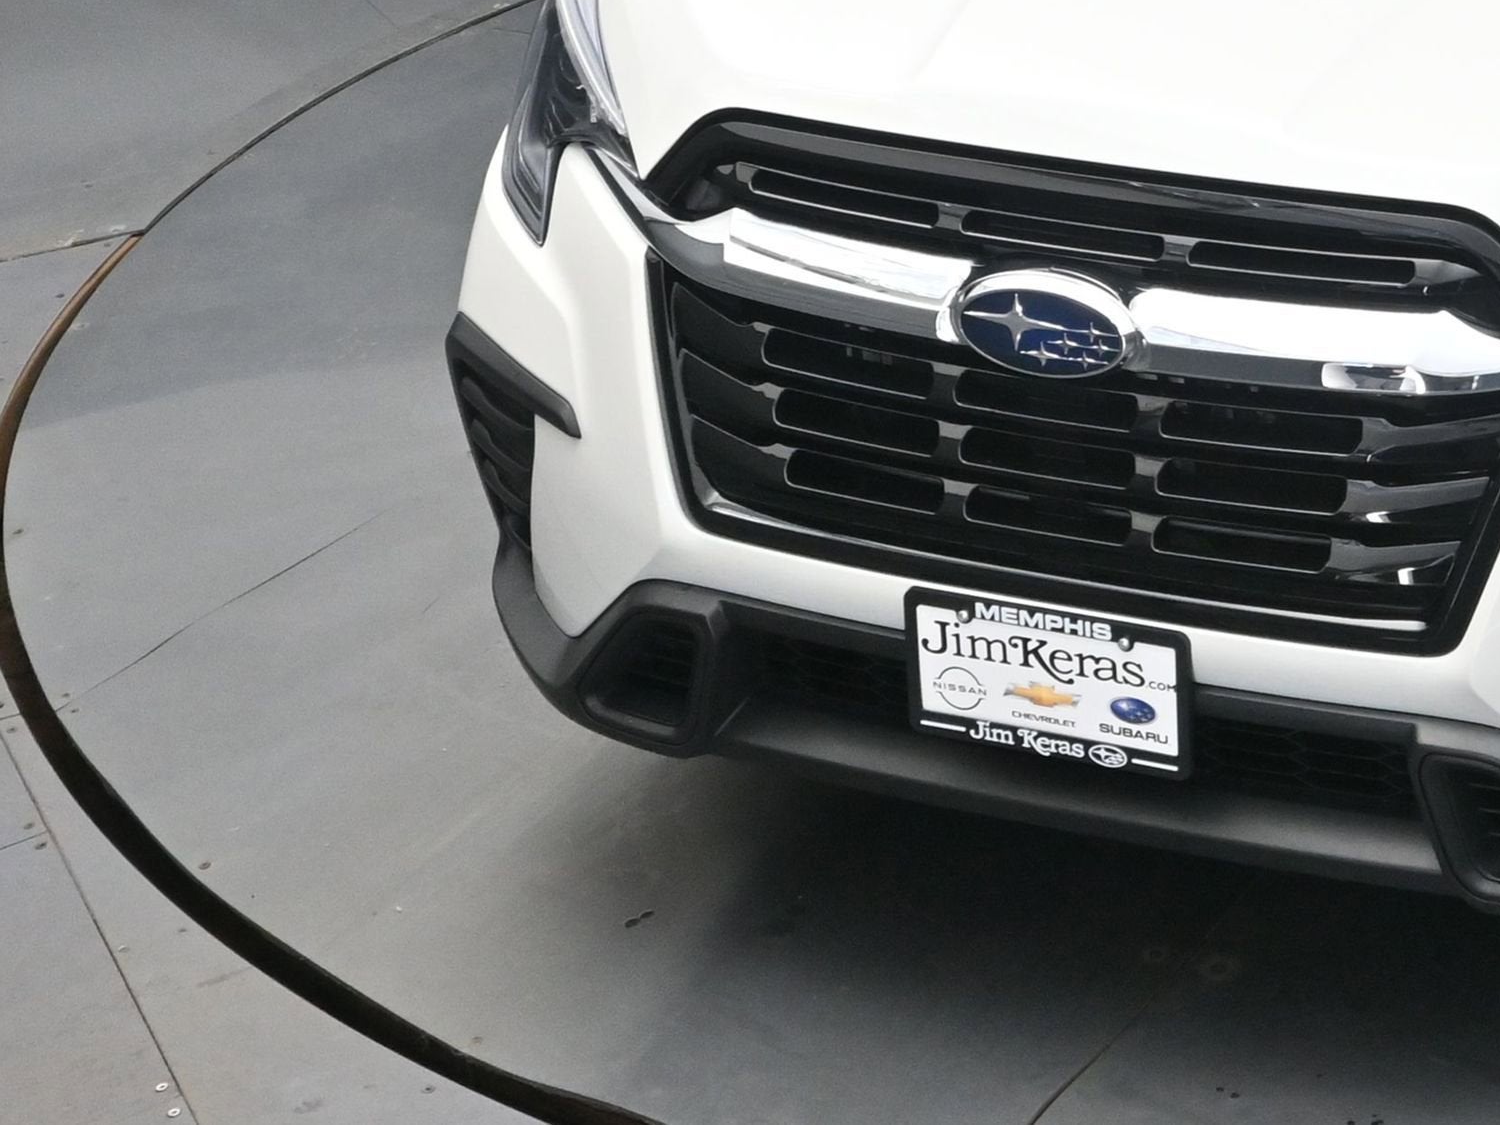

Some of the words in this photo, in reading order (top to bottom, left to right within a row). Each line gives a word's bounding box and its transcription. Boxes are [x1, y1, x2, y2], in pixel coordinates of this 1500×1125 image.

[974, 602, 1112, 641] MEMPHIS
[933, 681, 987, 696] NISSAN
[1011, 710, 1076, 728] CHEVROLET
[969, 720, 1015, 745] Jim
[1017, 729, 1085, 758] Keras
[1099, 723, 1169, 744] SUBARU
